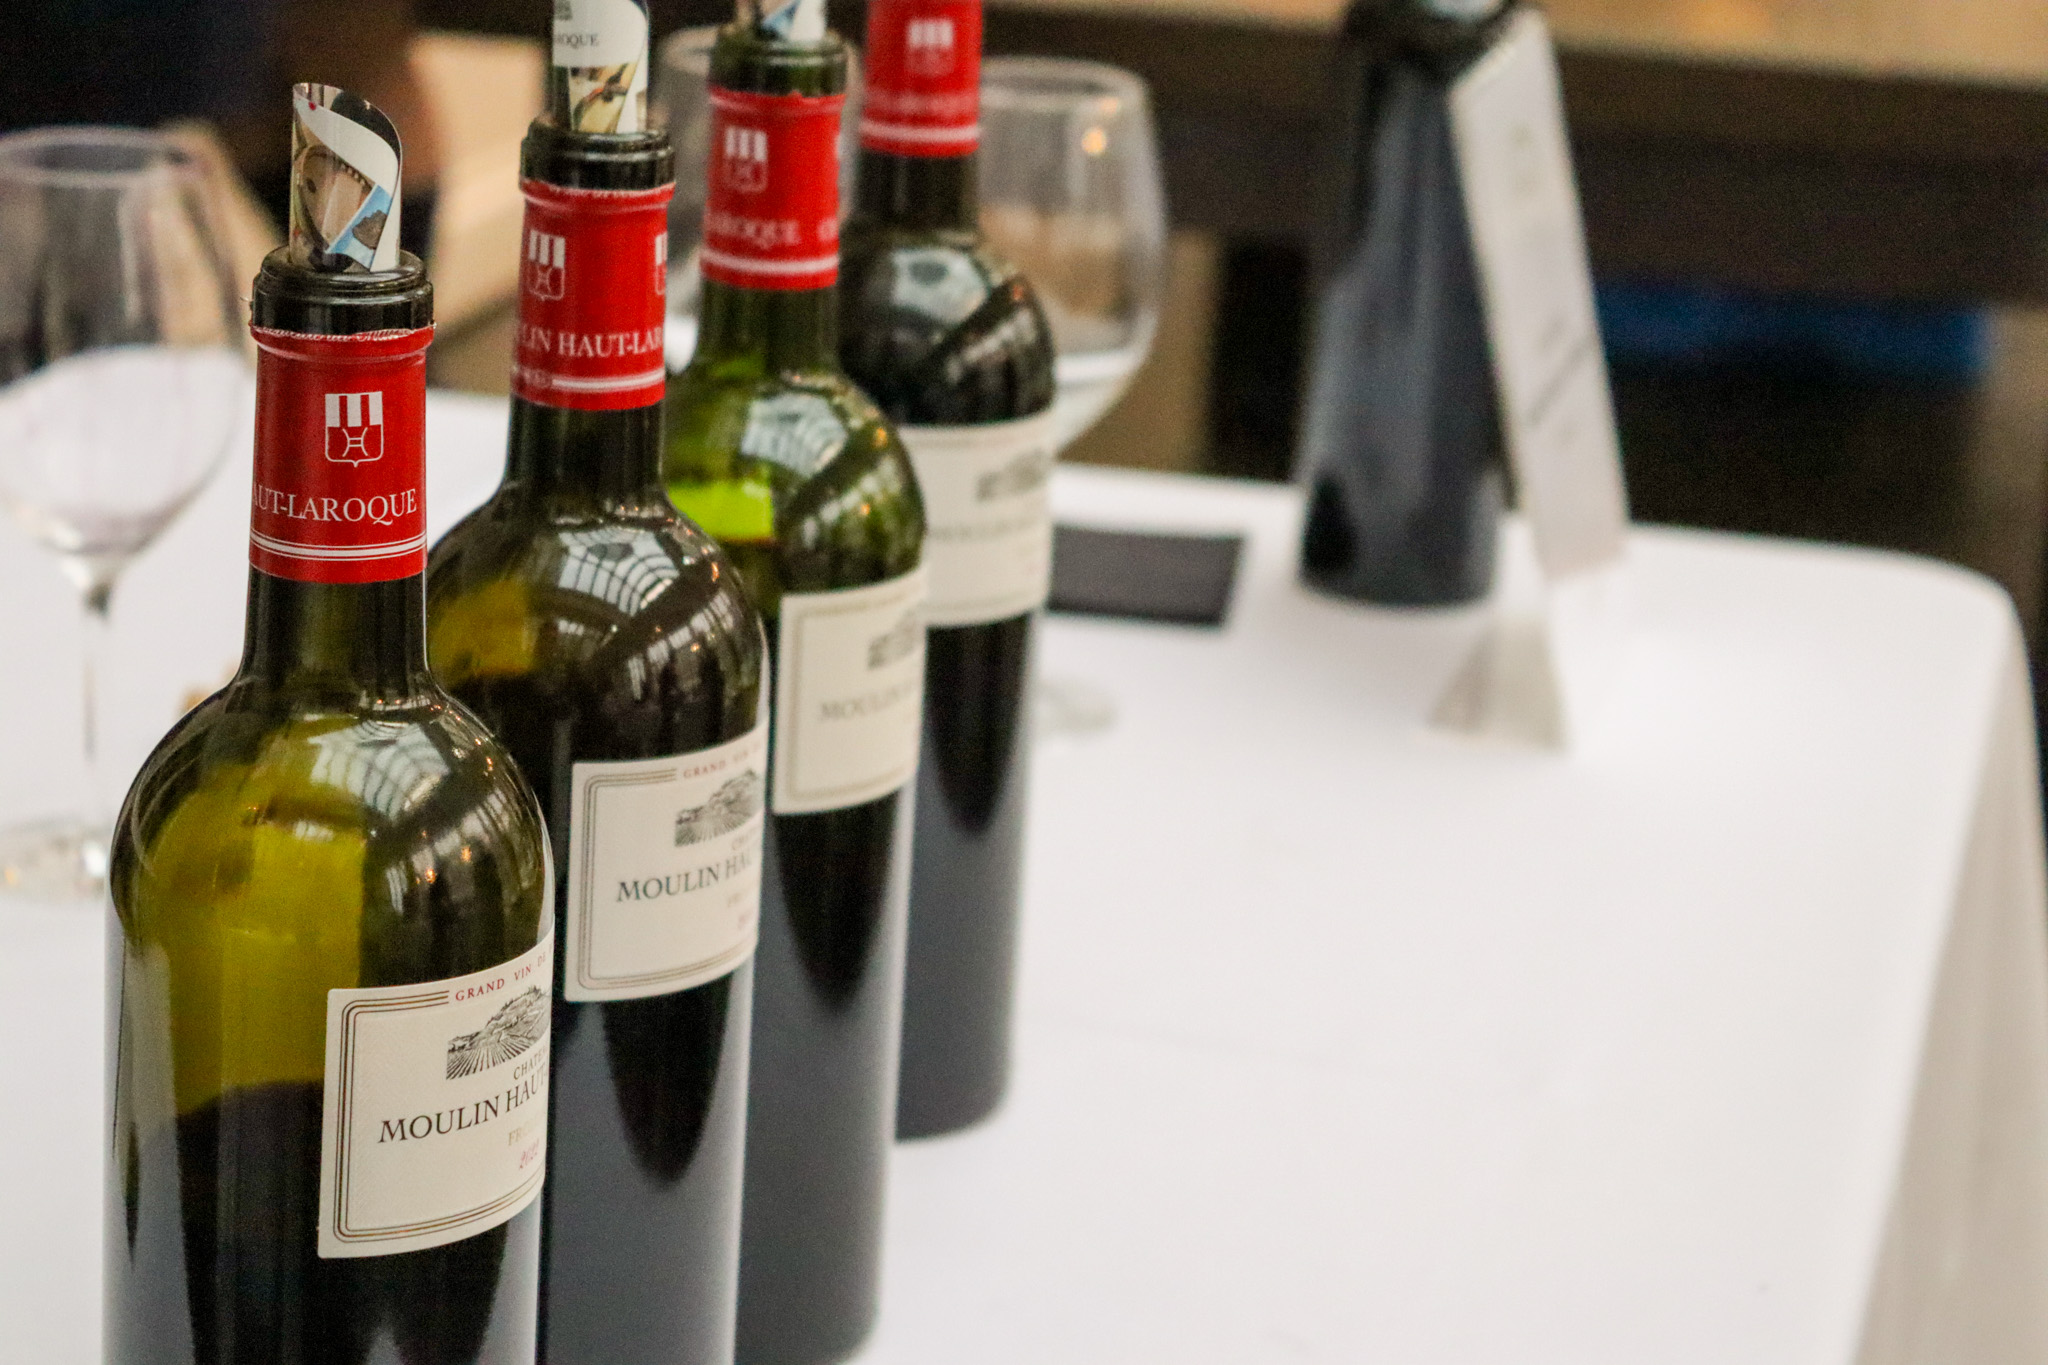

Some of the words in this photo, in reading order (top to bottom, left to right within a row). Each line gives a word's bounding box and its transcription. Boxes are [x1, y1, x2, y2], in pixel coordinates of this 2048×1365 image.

[616, 863, 721, 903] MOULIN
[455, 978, 505, 1001] GRAND
[514, 964, 532, 981] VIN
[377, 1095, 500, 1143] MOULIN
